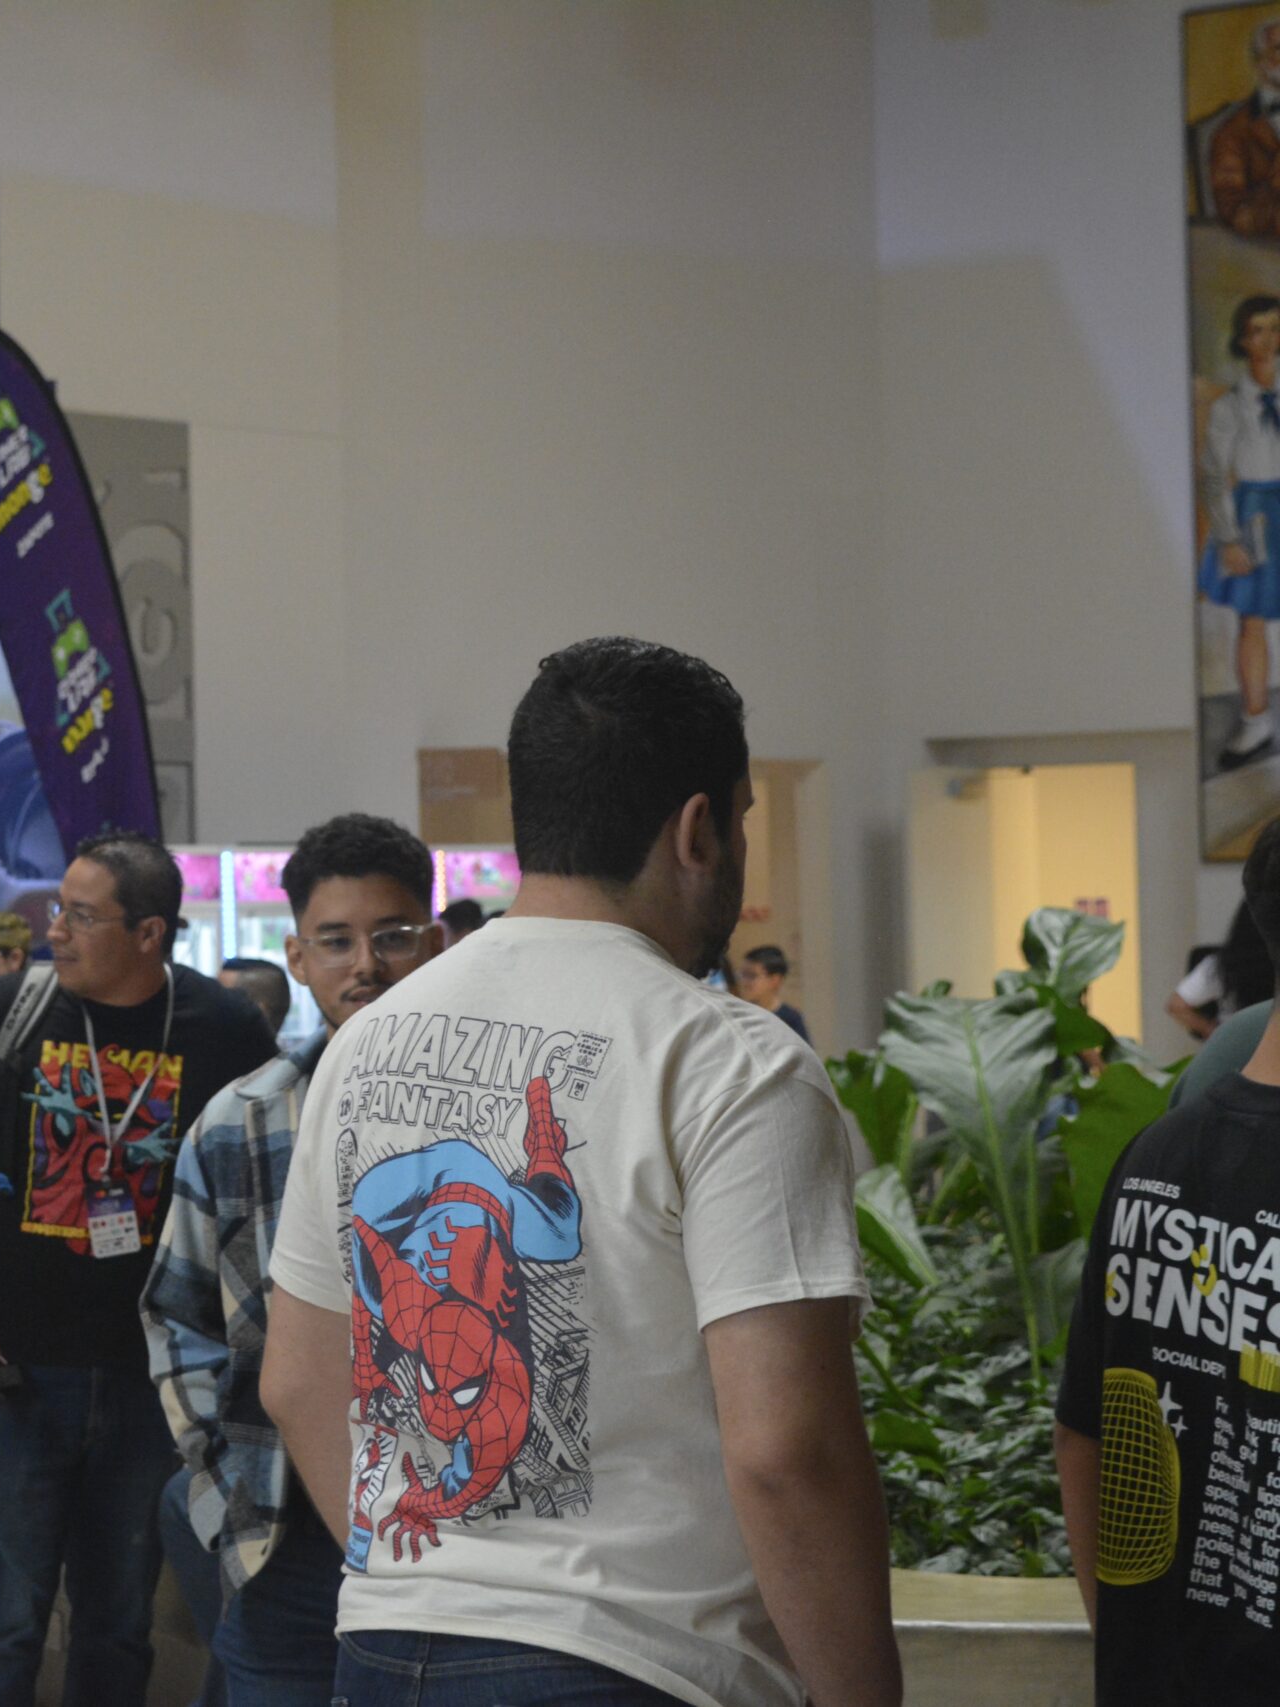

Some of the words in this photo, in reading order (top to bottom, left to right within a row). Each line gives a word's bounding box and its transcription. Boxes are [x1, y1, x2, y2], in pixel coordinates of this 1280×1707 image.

[343, 1012, 577, 1095] AMAZING
[352, 1080, 523, 1138] FANTASY
[1105, 1253, 1280, 1367] SENSES
[1152, 1346, 1200, 1371] SOCIAL
[1193, 1551, 1221, 1570] the
[1190, 1567, 1223, 1588] that
[1185, 1587, 1230, 1608] never
